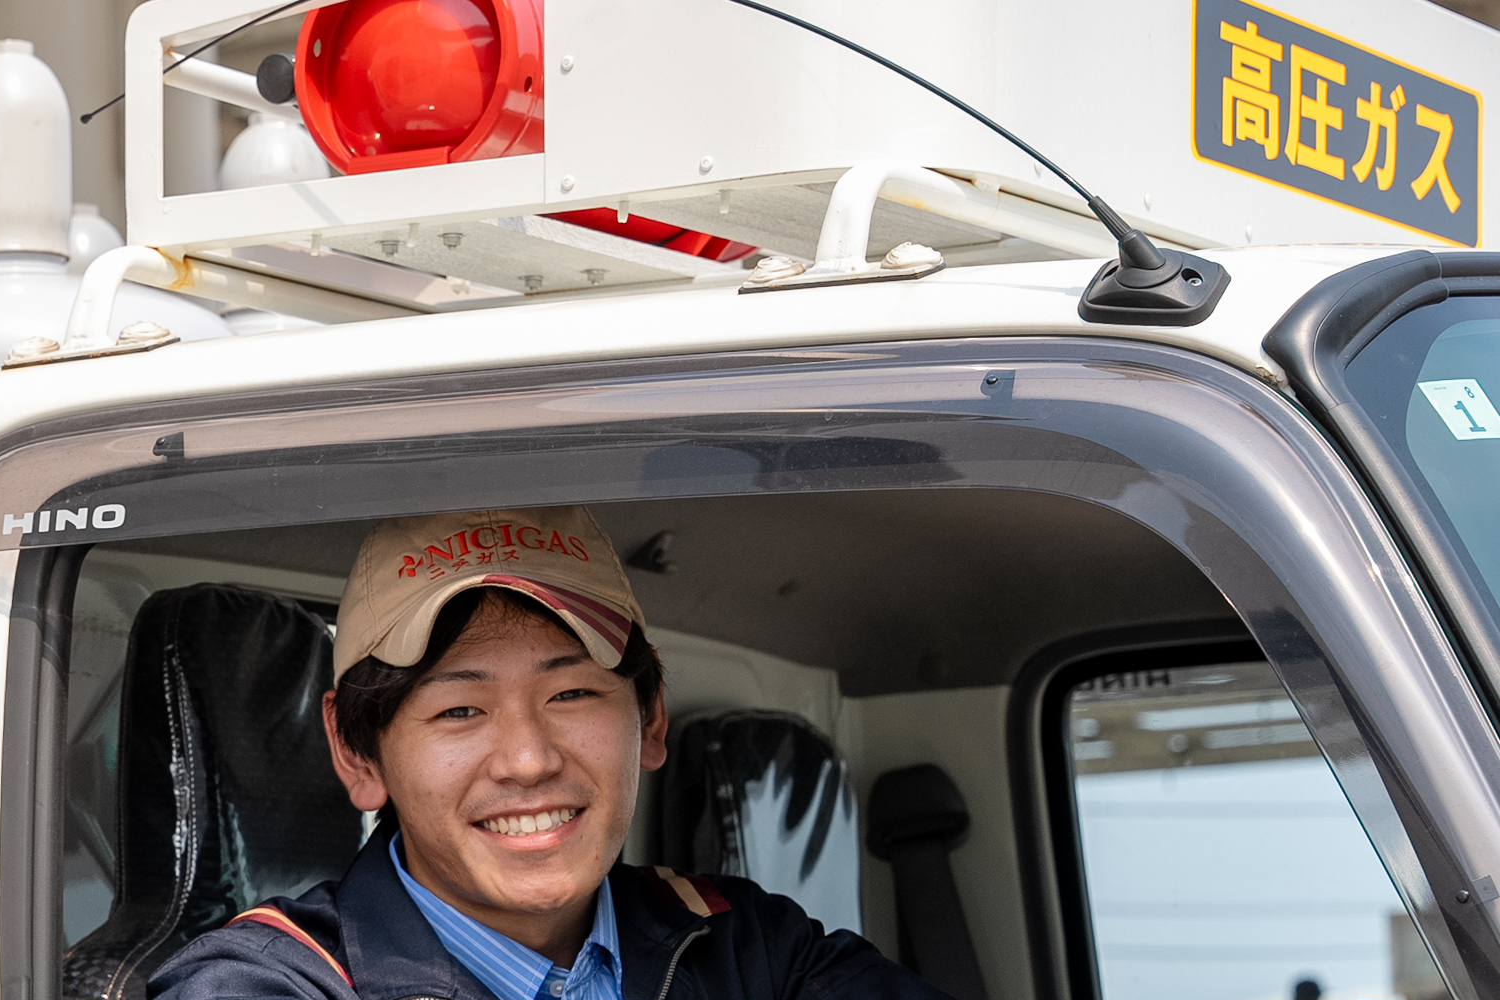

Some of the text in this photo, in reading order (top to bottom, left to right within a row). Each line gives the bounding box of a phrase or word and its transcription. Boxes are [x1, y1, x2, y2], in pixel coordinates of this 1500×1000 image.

[1220, 20, 1461, 214] 高圧ガス
[1463, 386, 1475, 399] 8
[1453, 400, 1487, 433] 1
[2, 504, 126, 535] HINO
[424, 524, 589, 569] NICIGAS
[429, 549, 520, 580] ニチガス
